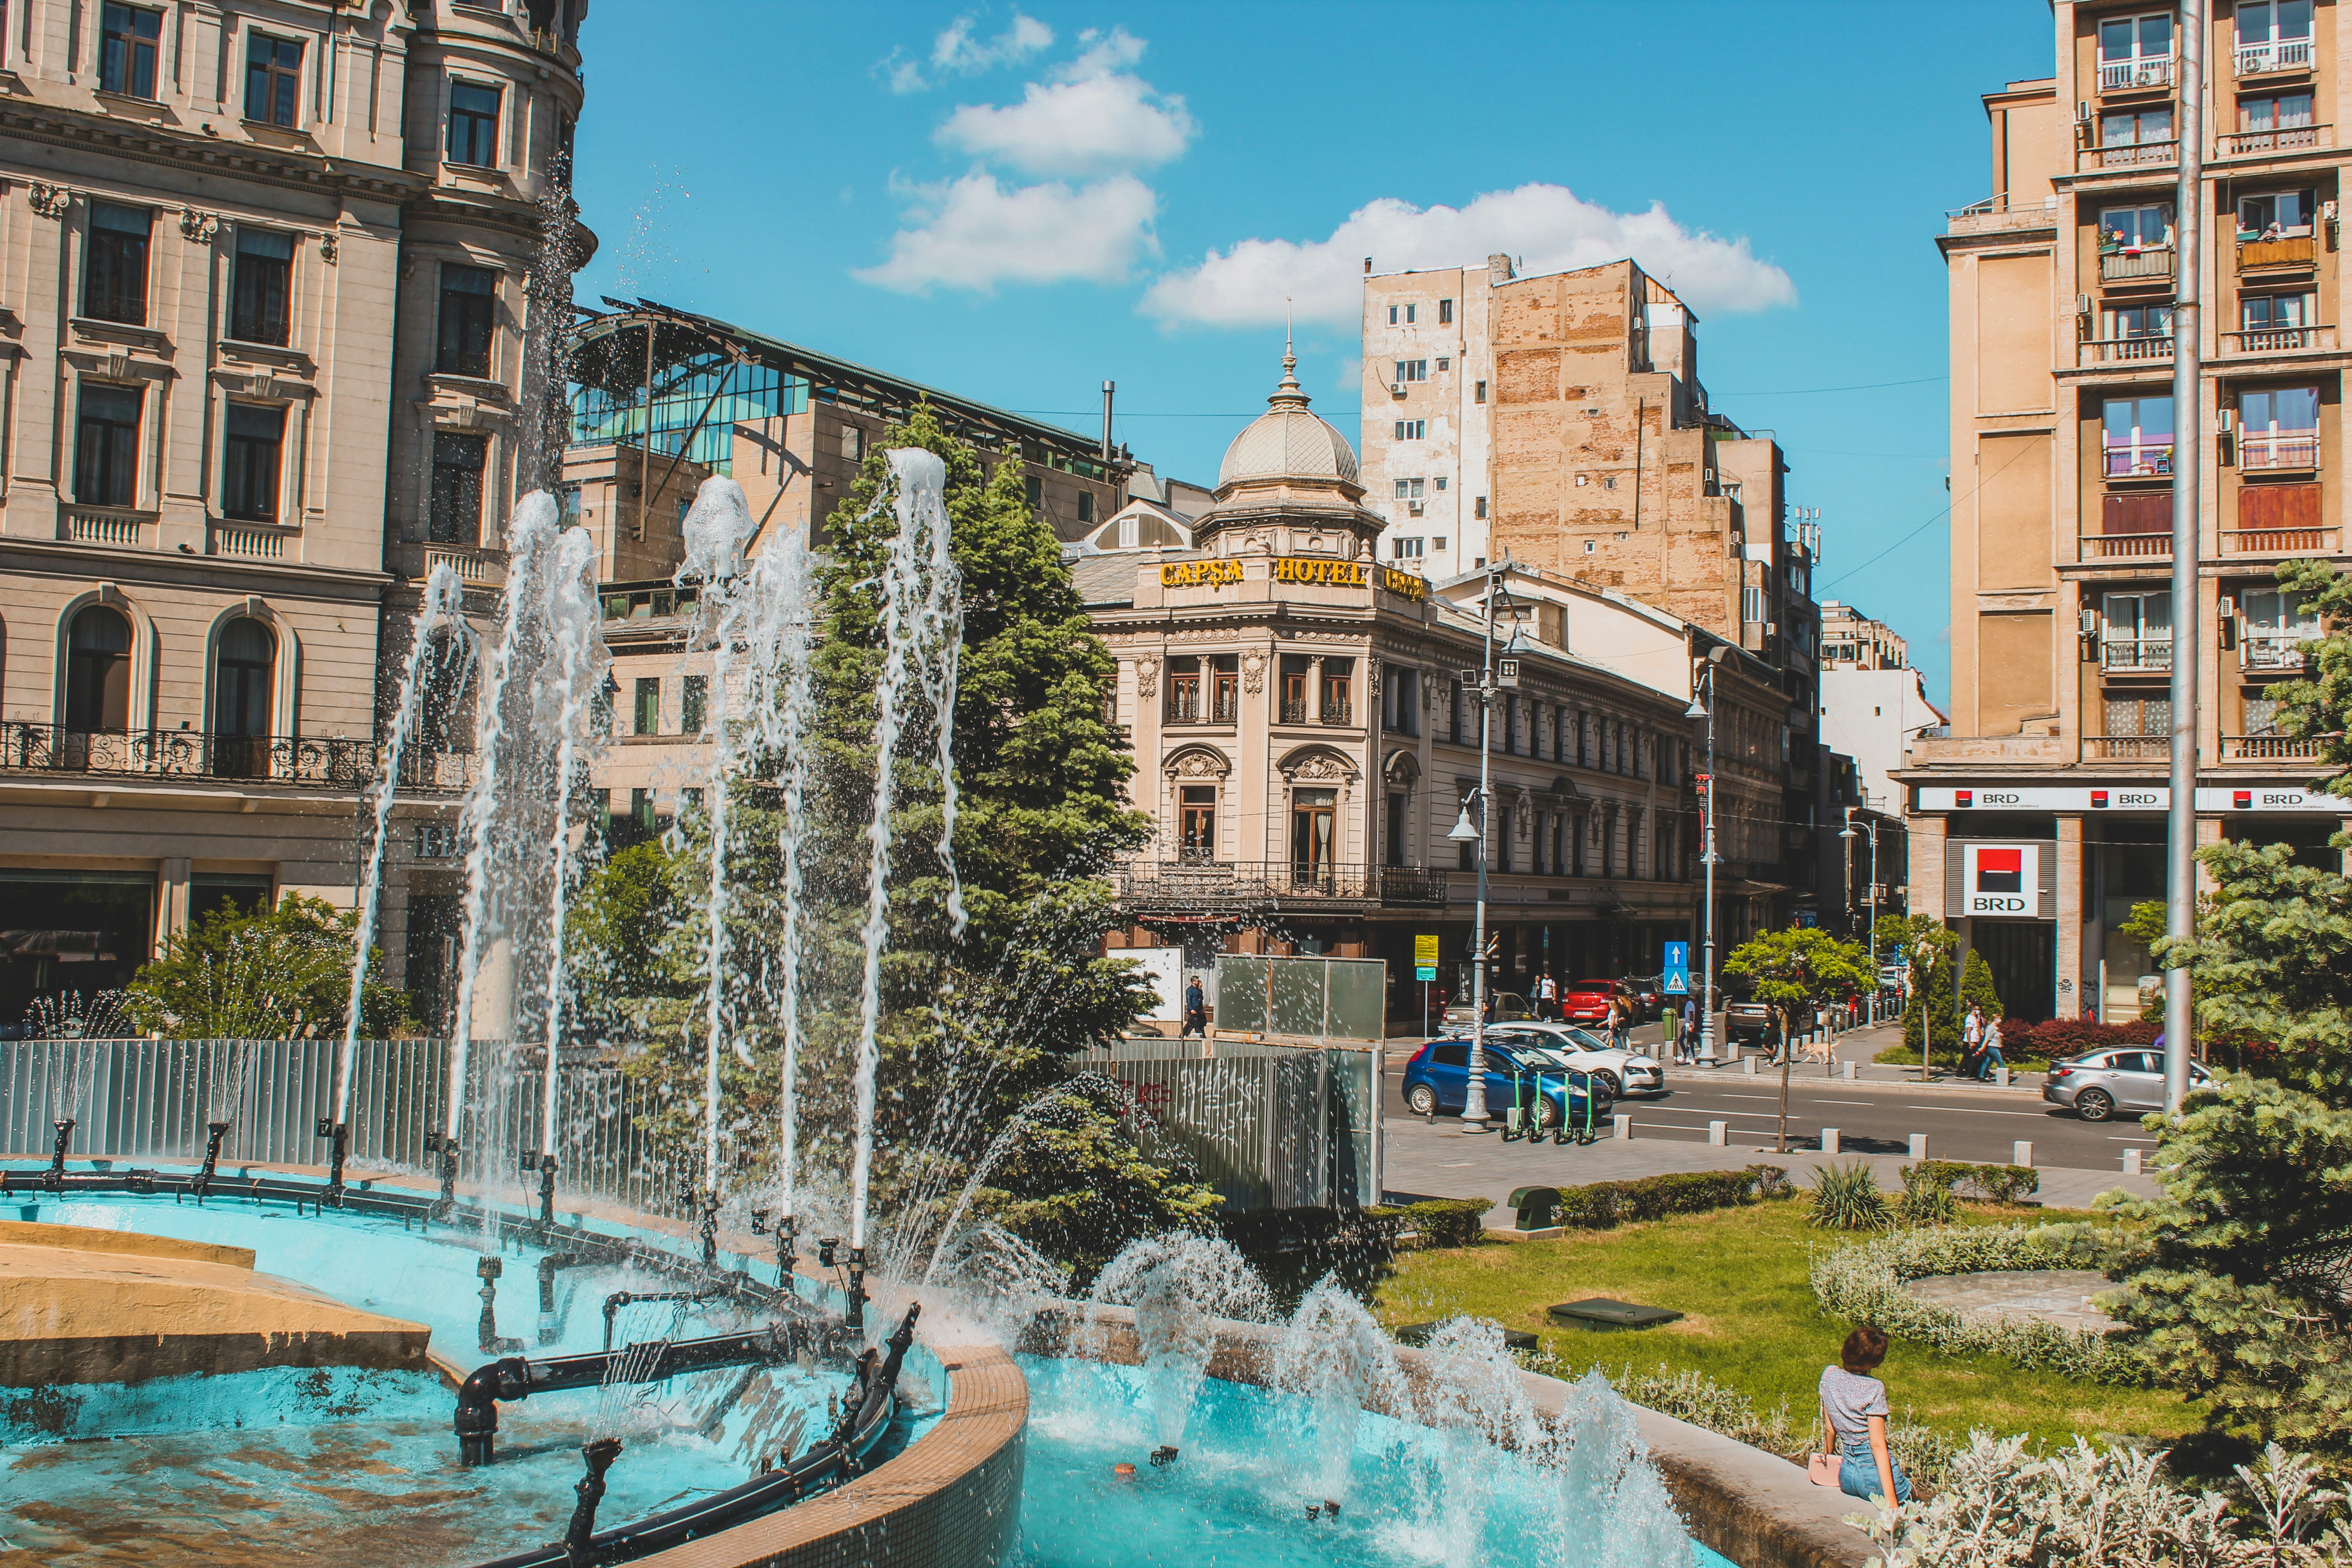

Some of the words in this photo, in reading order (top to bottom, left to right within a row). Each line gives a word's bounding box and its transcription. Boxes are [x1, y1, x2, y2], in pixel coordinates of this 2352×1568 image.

[1277, 558, 1366, 584] HOTEL
[1983, 794, 2019, 804] BRD
[2119, 794, 2157, 804] BRD
[2263, 794, 2303, 804] BRD
[1973, 898, 2025, 911] BRD
